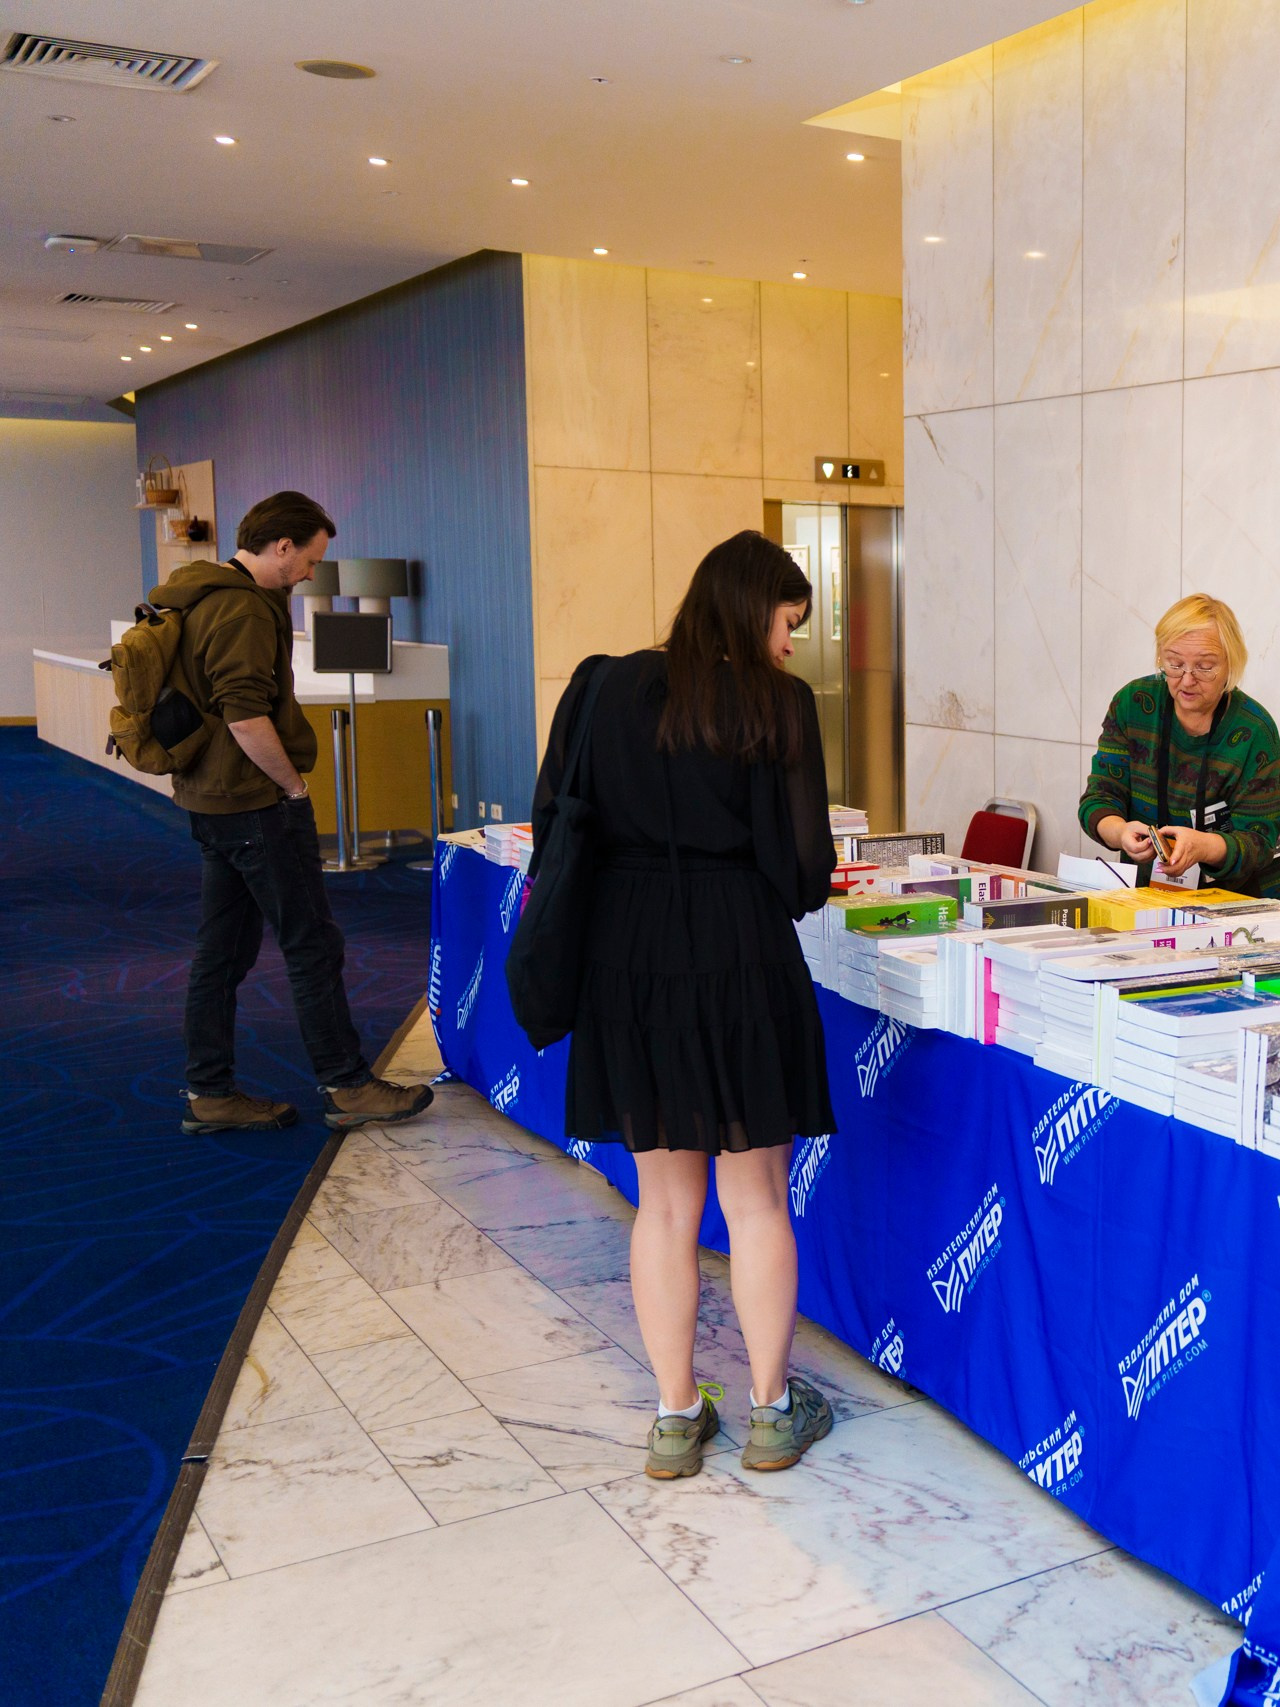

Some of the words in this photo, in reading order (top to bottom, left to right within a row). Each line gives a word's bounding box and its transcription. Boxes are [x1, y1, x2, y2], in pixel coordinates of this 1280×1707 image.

[1032, 1082, 1084, 1144] ИЗДАТЕЛЬСК
[1062, 1098, 1120, 1165] WWW.PITER.COM
[926, 1204, 983, 1281] ИЗДАТЕЛЬСКИЙ
[983, 1182, 999, 1209] ДОМ
[957, 1202, 1003, 1283] ПИТЕР
[881, 1317, 896, 1341] ДОМ
[1118, 1297, 1176, 1375] ИЗДАТЕЛЬСКИЙ
[1179, 1273, 1200, 1304] ДОМ
[1145, 1296, 1207, 1388] ПИТЕР
[1145, 1338, 1209, 1402] WWW.PITER.COM
[1063, 1410, 1077, 1435] ДОМ
